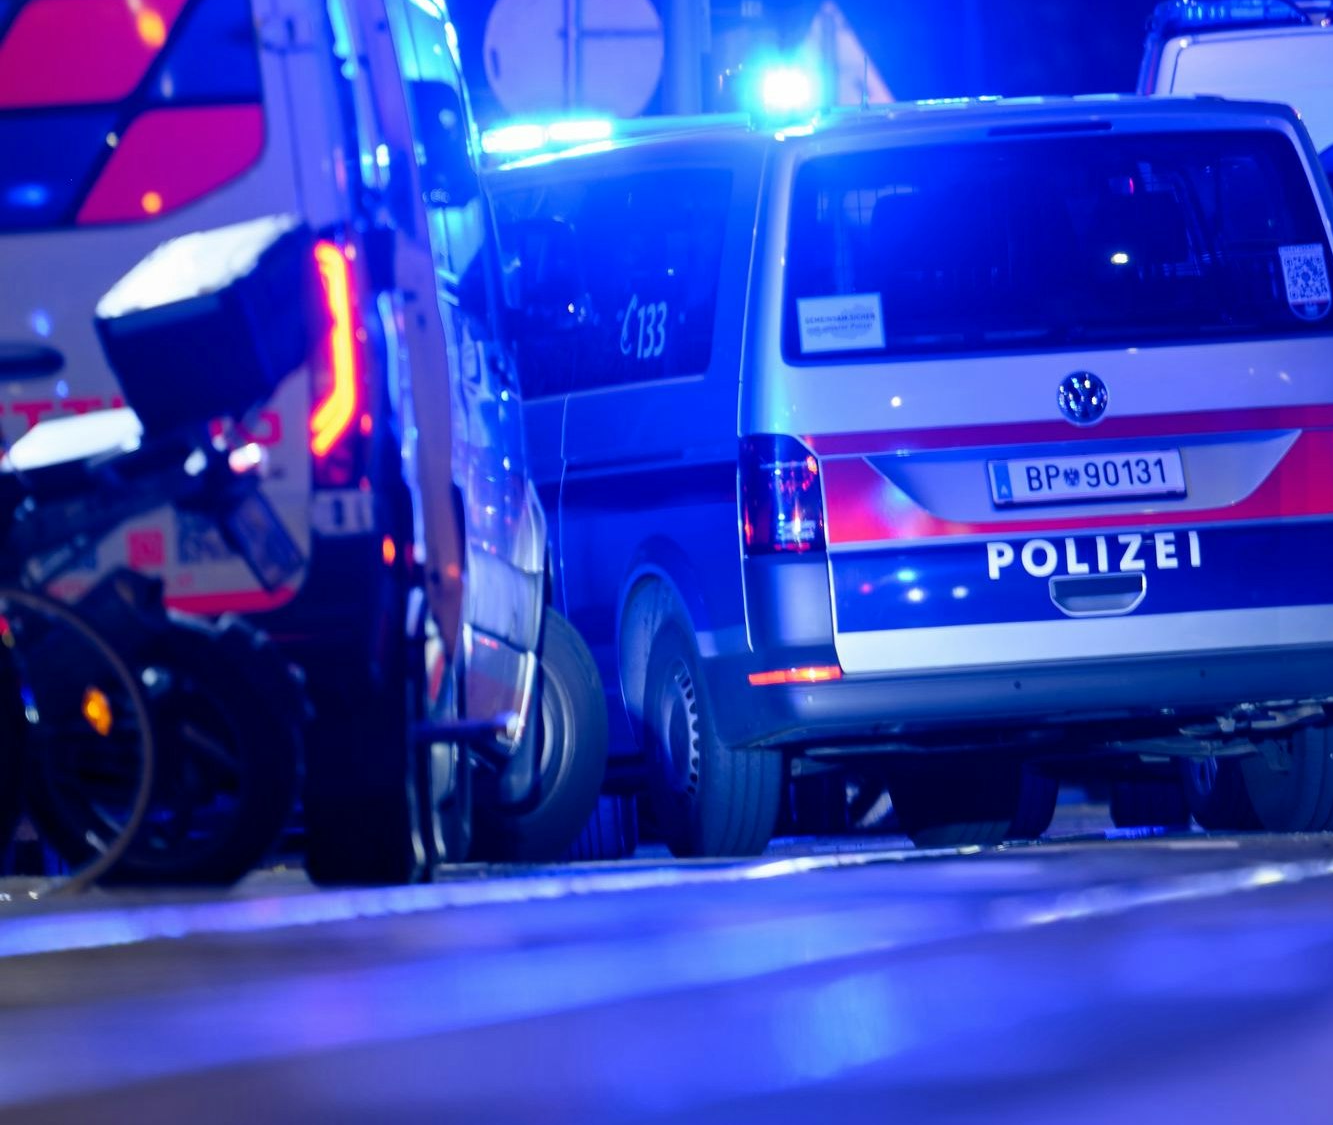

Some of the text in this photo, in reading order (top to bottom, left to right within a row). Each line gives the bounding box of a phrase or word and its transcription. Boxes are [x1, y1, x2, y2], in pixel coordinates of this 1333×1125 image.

[637, 301, 667, 359] 133
[1025, 457, 1167, 492] BP 90131
[986, 530, 1202, 581] POLIZEI
